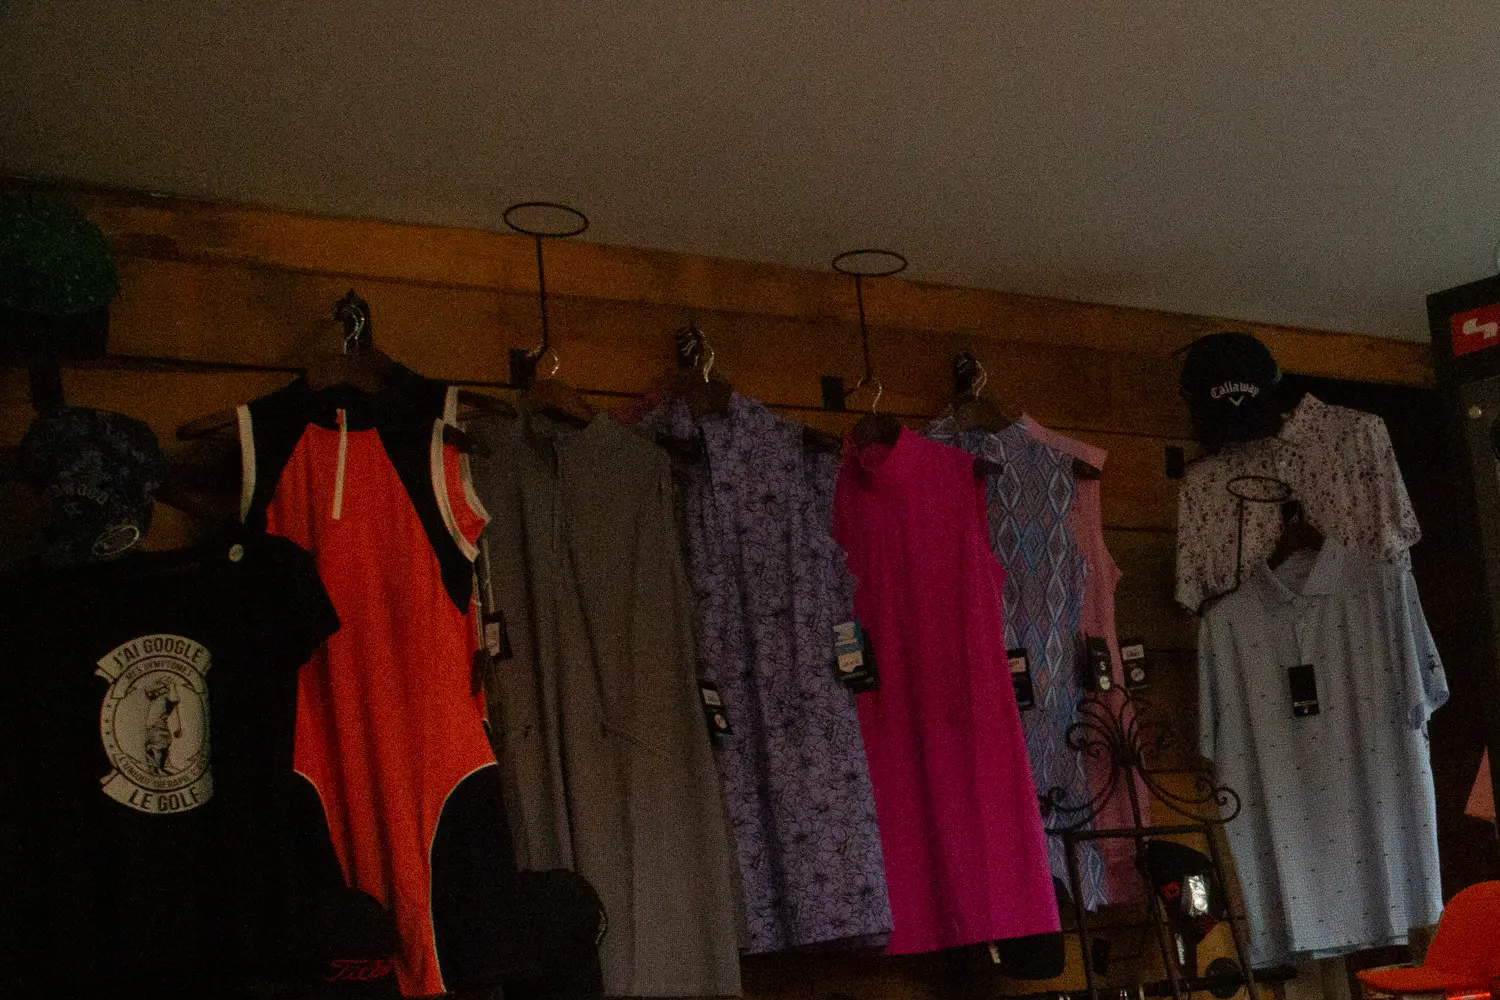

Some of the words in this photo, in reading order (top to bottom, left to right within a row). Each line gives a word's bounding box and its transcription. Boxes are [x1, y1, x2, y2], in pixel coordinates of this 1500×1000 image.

[1210, 381, 1260, 399] Callaway
[113, 643, 141, 669] J'AI
[143, 636, 203, 663] GOOGLE
[129, 788, 151, 811] LE
[156, 787, 199, 812] GOLF
